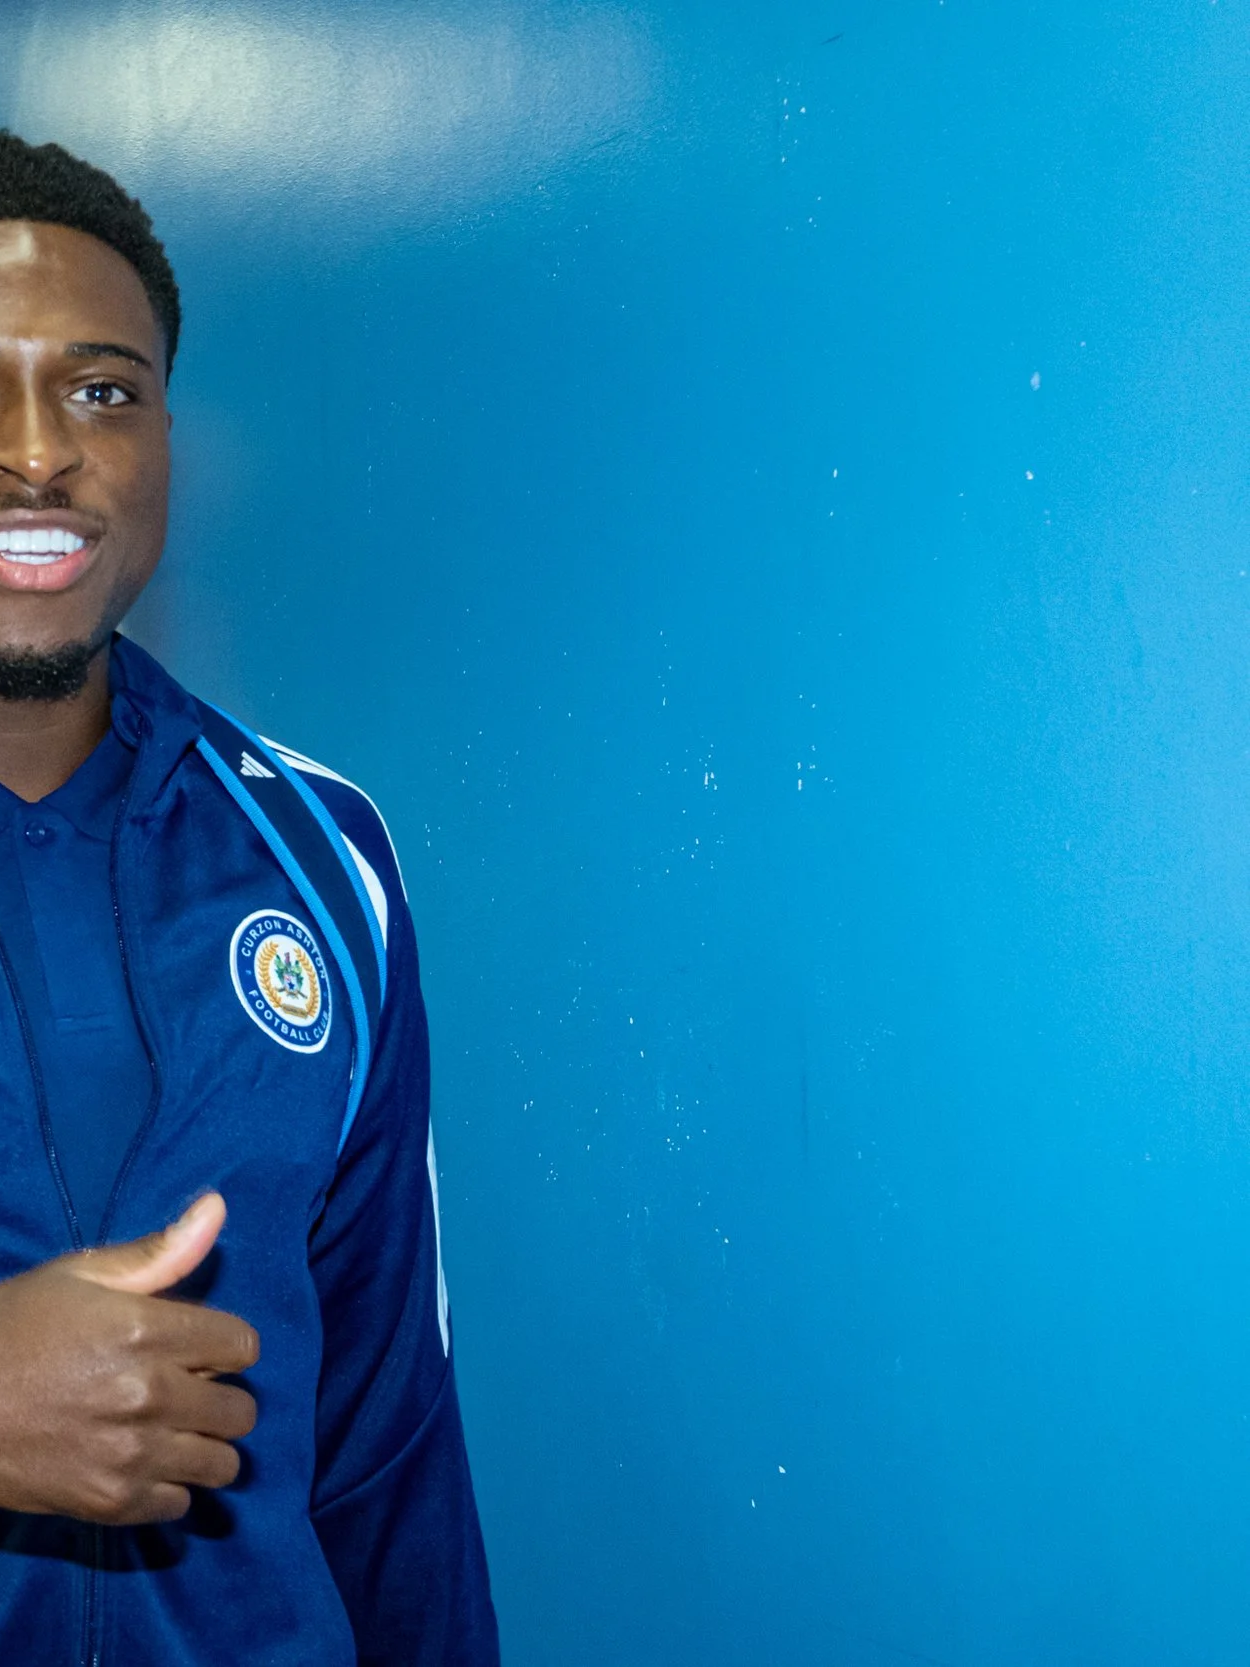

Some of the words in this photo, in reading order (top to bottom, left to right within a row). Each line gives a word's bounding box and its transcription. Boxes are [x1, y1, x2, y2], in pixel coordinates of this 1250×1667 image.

[241, 919, 282, 958] CURZON
[287, 924, 327, 979] ASHTON
[248, 989, 312, 1042] FOOTBALL
